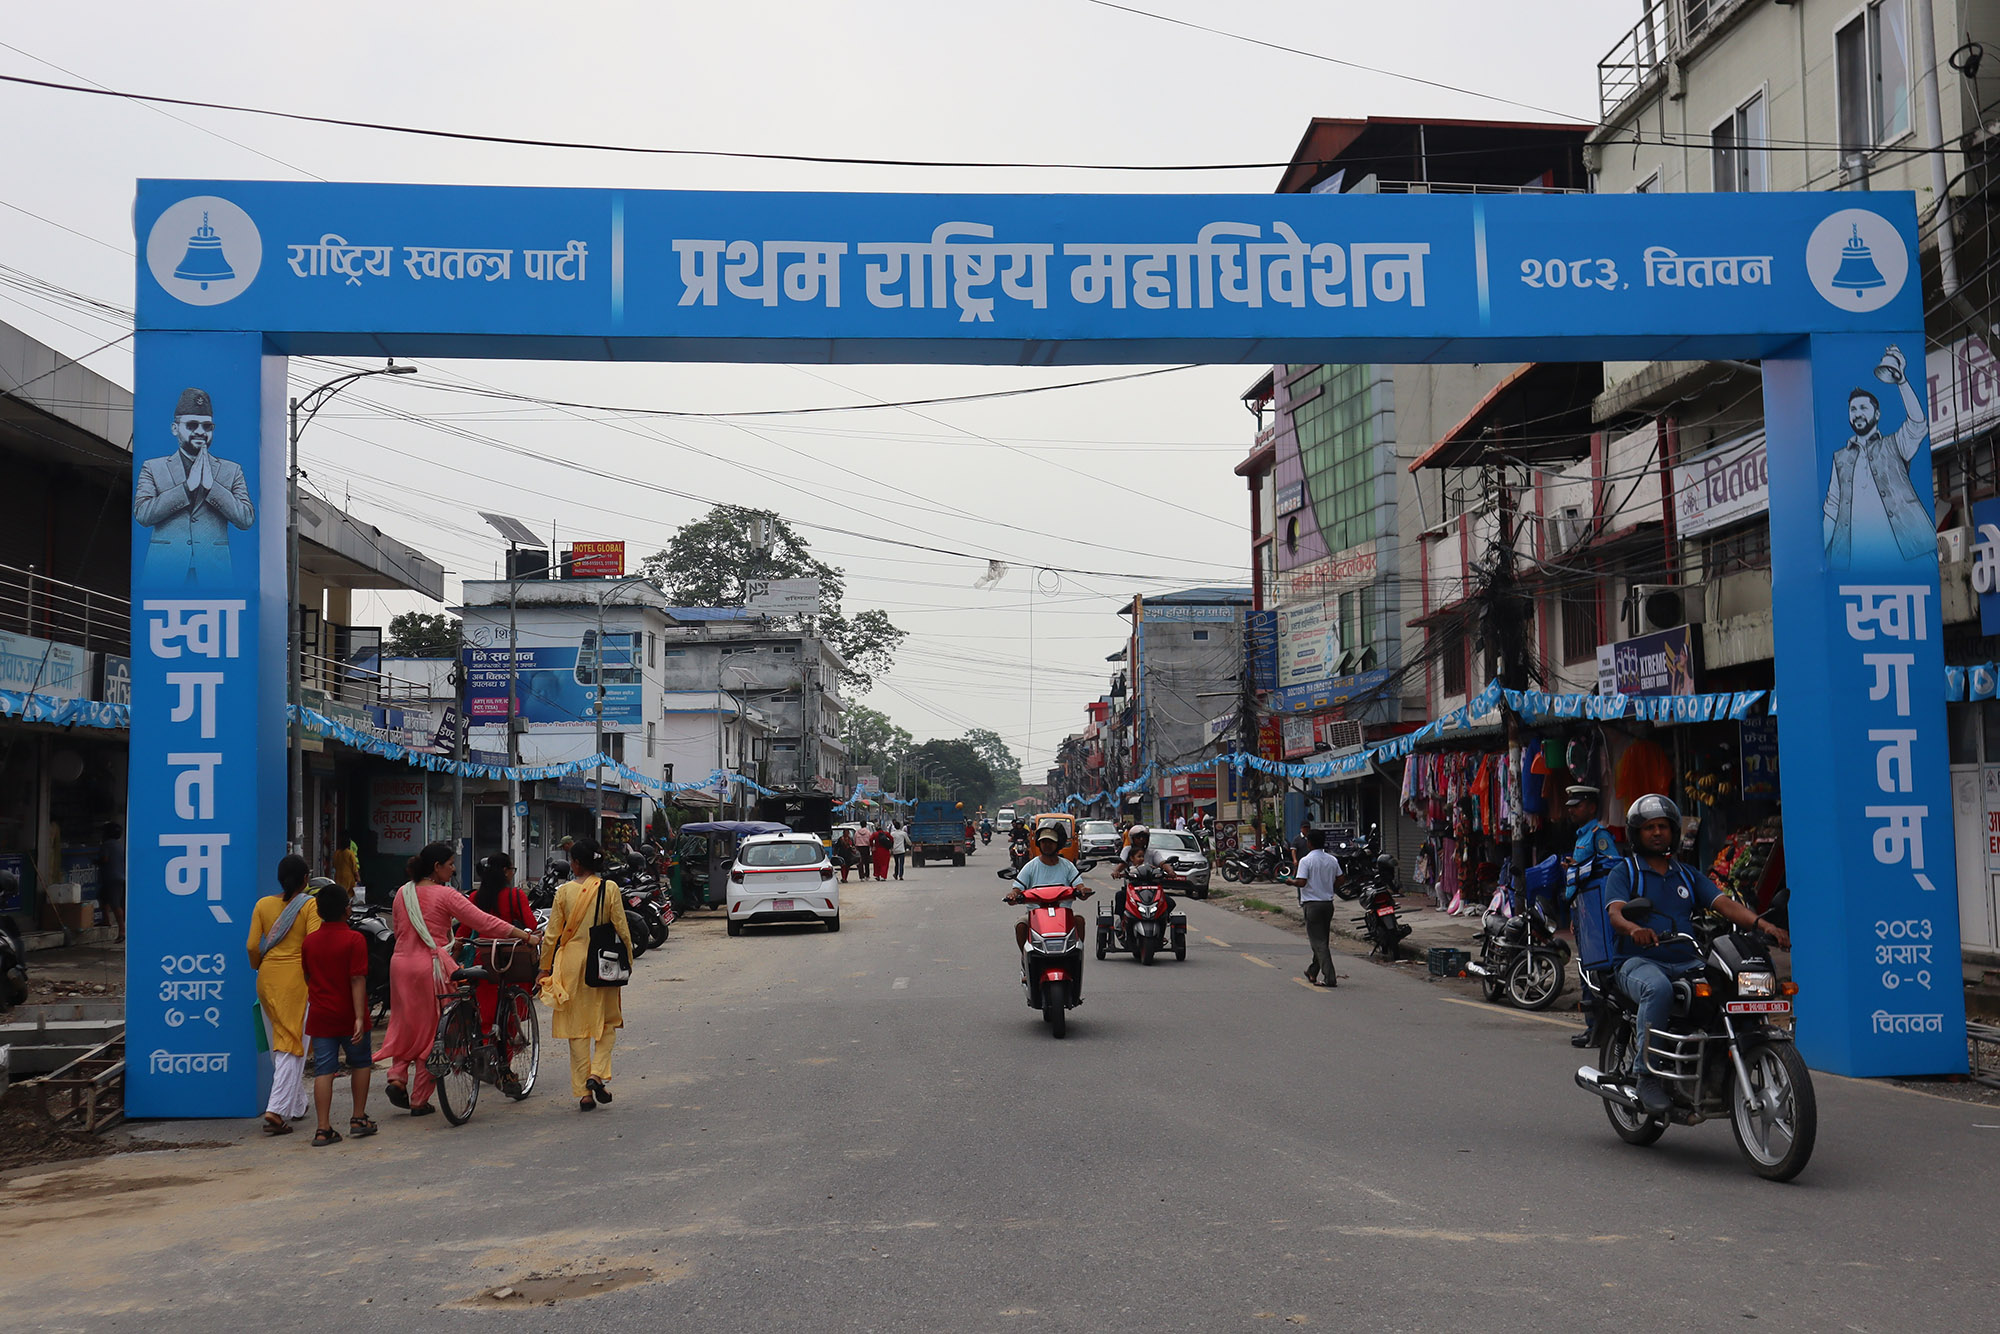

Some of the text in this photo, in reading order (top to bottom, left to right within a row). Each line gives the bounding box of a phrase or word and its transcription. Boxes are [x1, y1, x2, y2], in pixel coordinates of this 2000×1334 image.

[288, 234, 588, 286] राष्ट्रिय स्वतन्त्र पार्टी
[1643, 246, 1774, 288] चितवन
[672, 222, 1430, 322] प्रथम राष्ट्रिय महाधिवेशन
[574, 543, 623, 553] HOTEL GLOBAL
[1640, 652, 1668, 677] XTREME
[392, 811, 423, 824] उपचार
[383, 825, 412, 842] केन्द्र
[1875, 920, 1932, 939] २०८३
[161, 953, 226, 975] २०८३
[1875, 945, 1933, 964] असार
[160, 980, 225, 1001] असार
[1872, 1010, 1944, 1034] चितवन
[149, 1049, 230, 1075] चितवन
